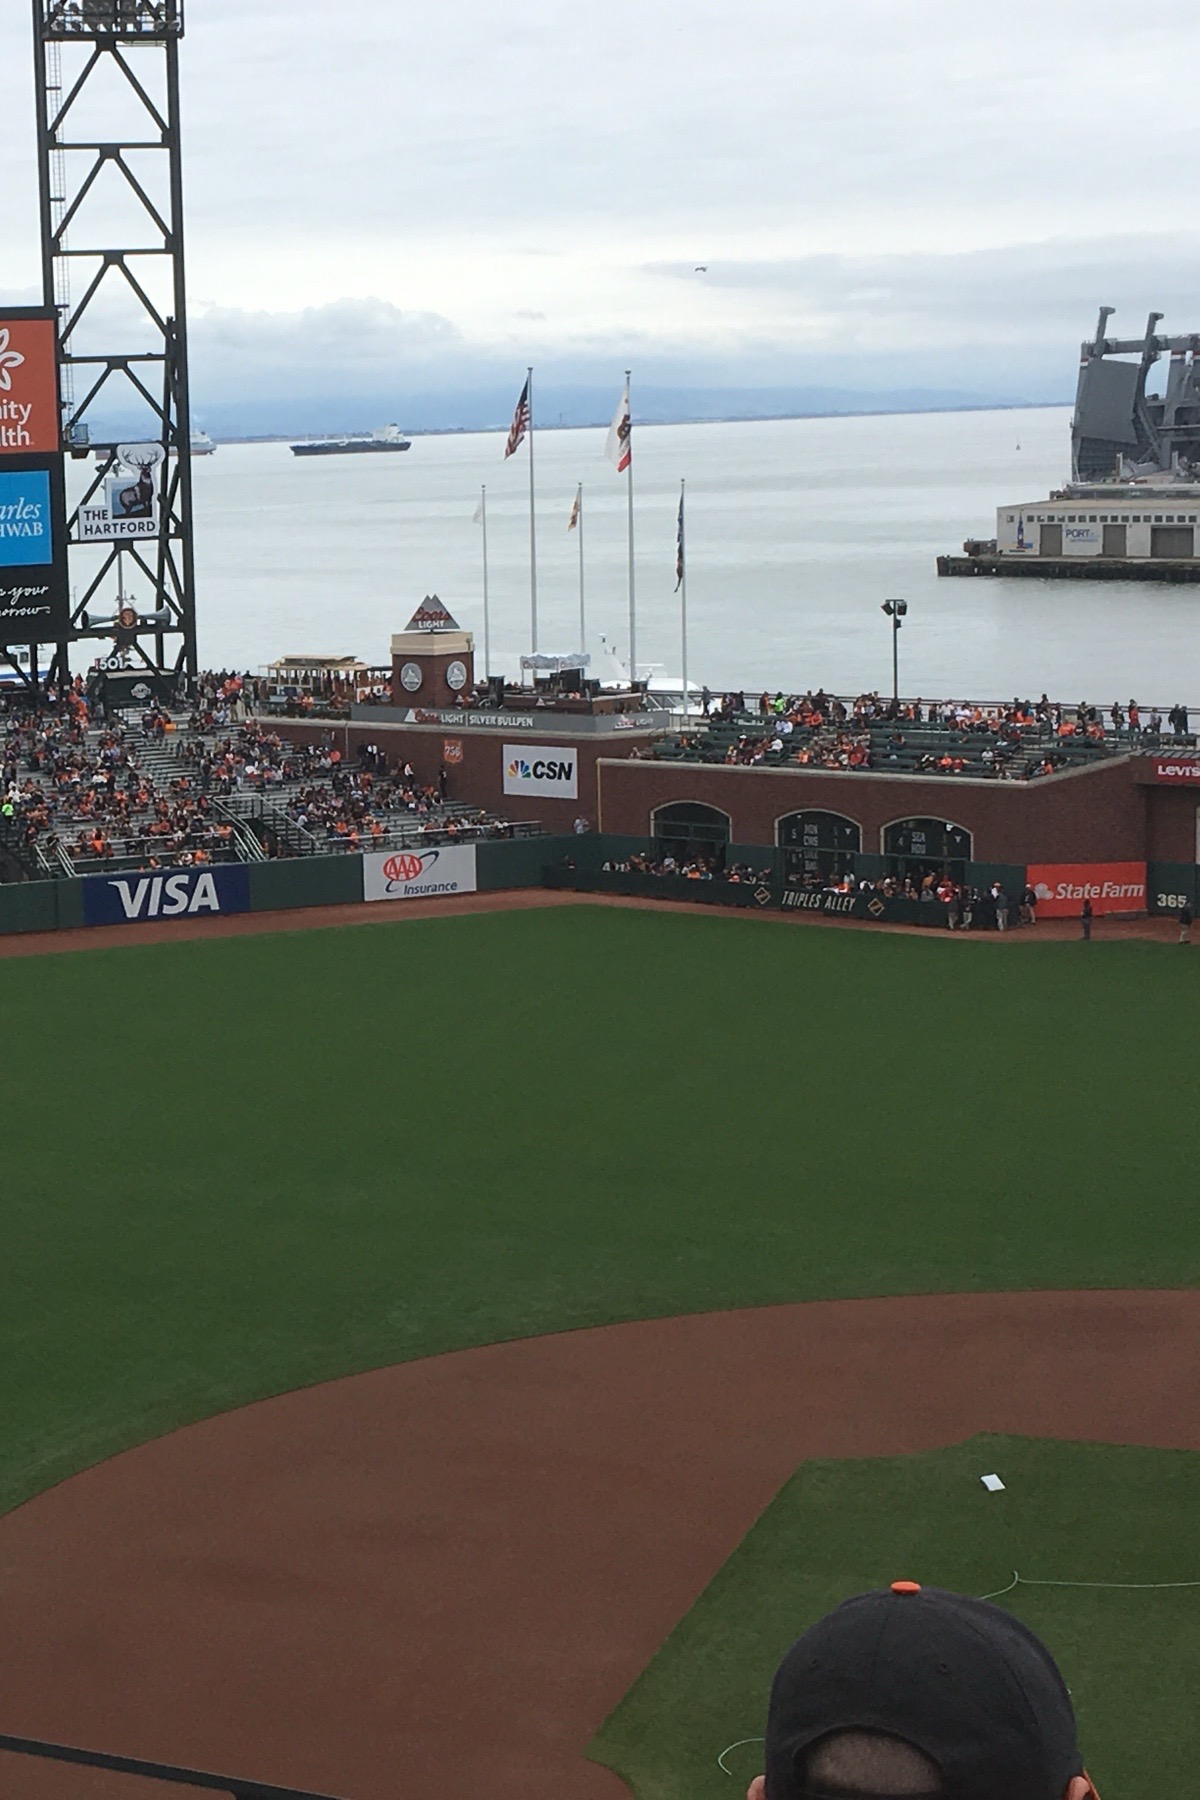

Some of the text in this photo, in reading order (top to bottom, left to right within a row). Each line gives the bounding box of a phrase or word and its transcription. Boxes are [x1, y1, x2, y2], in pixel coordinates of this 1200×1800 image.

[84, 510, 108, 521] THE
[84, 521, 156, 535] HARTFORD
[7, 585, 49, 605] your
[418, 620, 445, 628] LIGHT
[441, 713, 464, 724] LIGHT
[469, 714, 496, 725] SILVER
[497, 716, 534, 726] BULLPEN
[532, 759, 573, 781] CSN
[386, 855, 420, 881] AAA
[108, 873, 220, 918] VISA
[404, 881, 458, 895] Insurance
[1055, 881, 1144, 900] State Farm
[781, 890, 856, 911] TRIPLES ALLEY
[1157, 893, 1187, 908] 365
